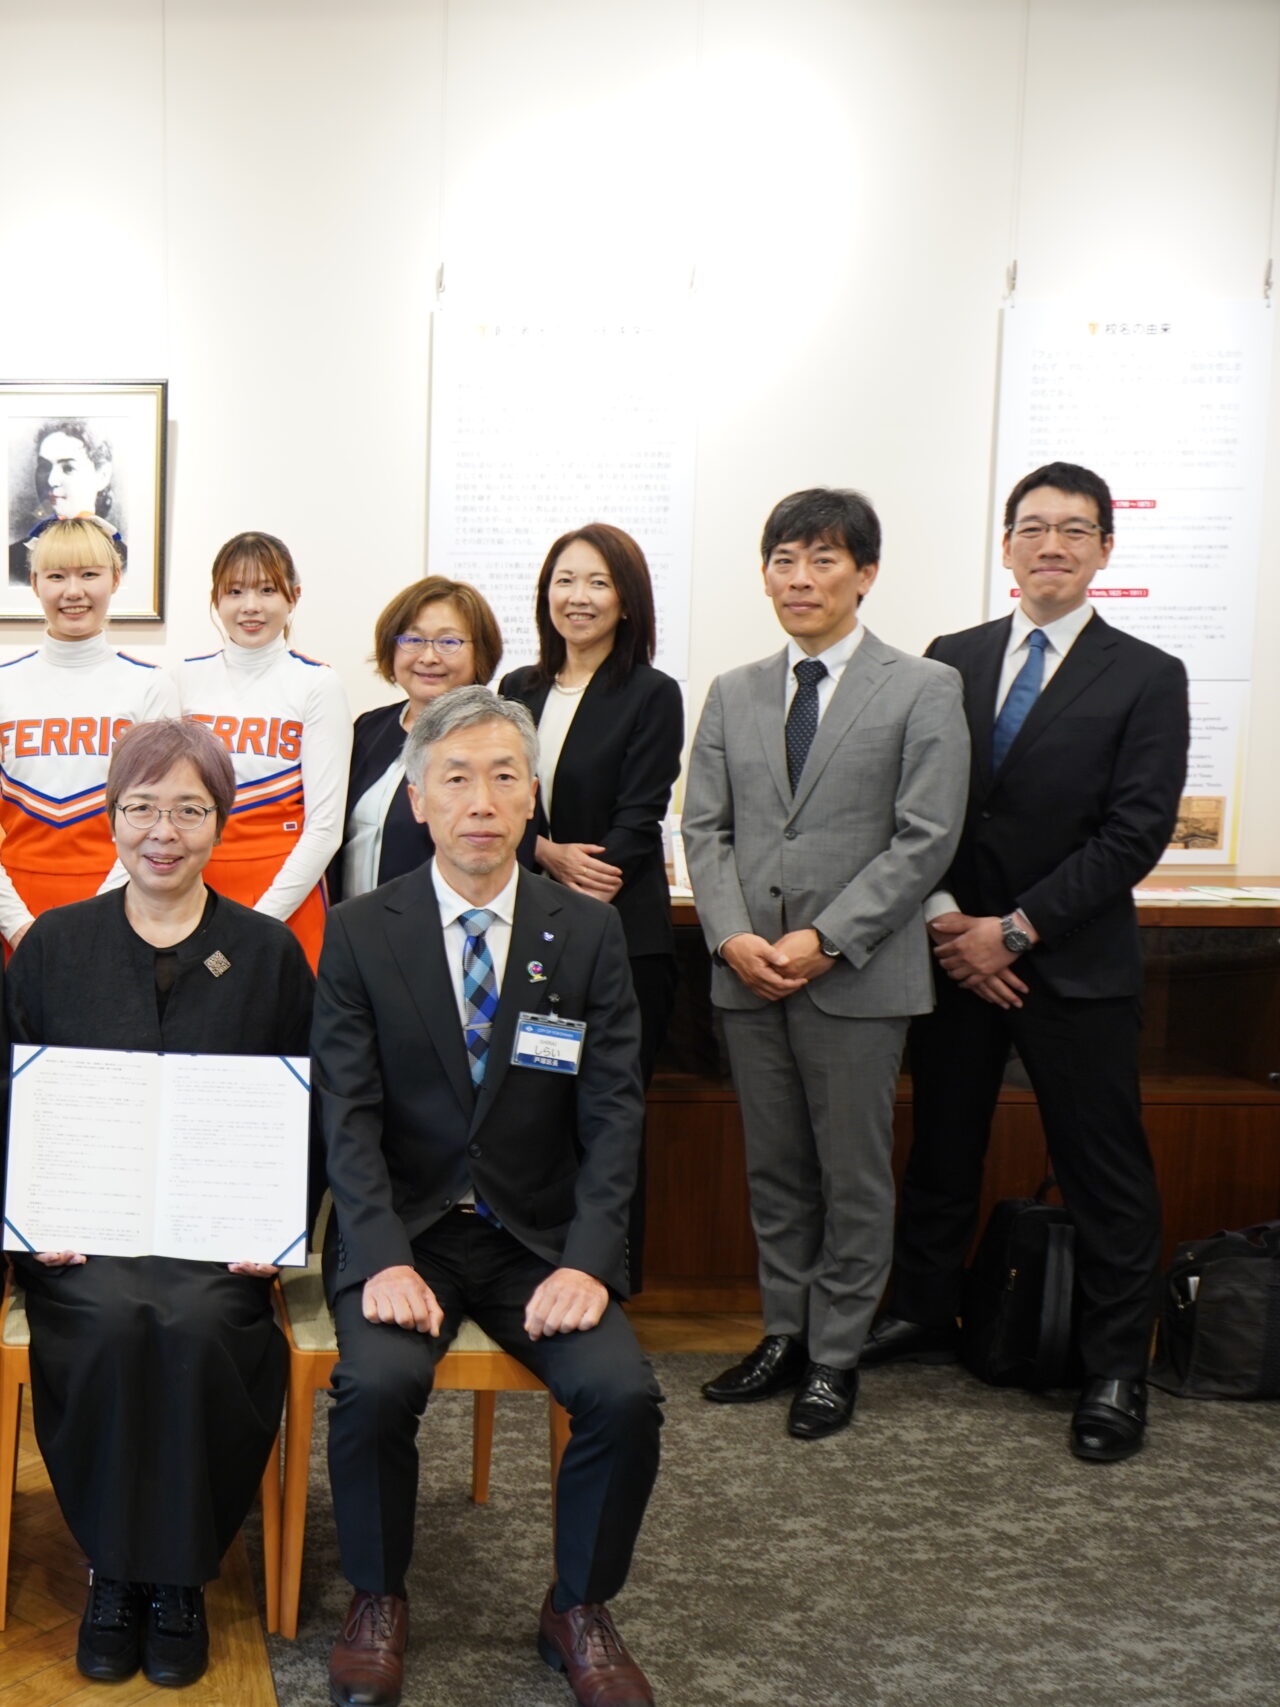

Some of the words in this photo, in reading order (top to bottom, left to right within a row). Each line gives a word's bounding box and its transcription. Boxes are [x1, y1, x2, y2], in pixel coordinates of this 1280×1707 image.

[1105, 322, 1171, 336] 校名の由来
[184, 713, 304, 761] RRIS
[534, 1045, 561, 1058] しらい
